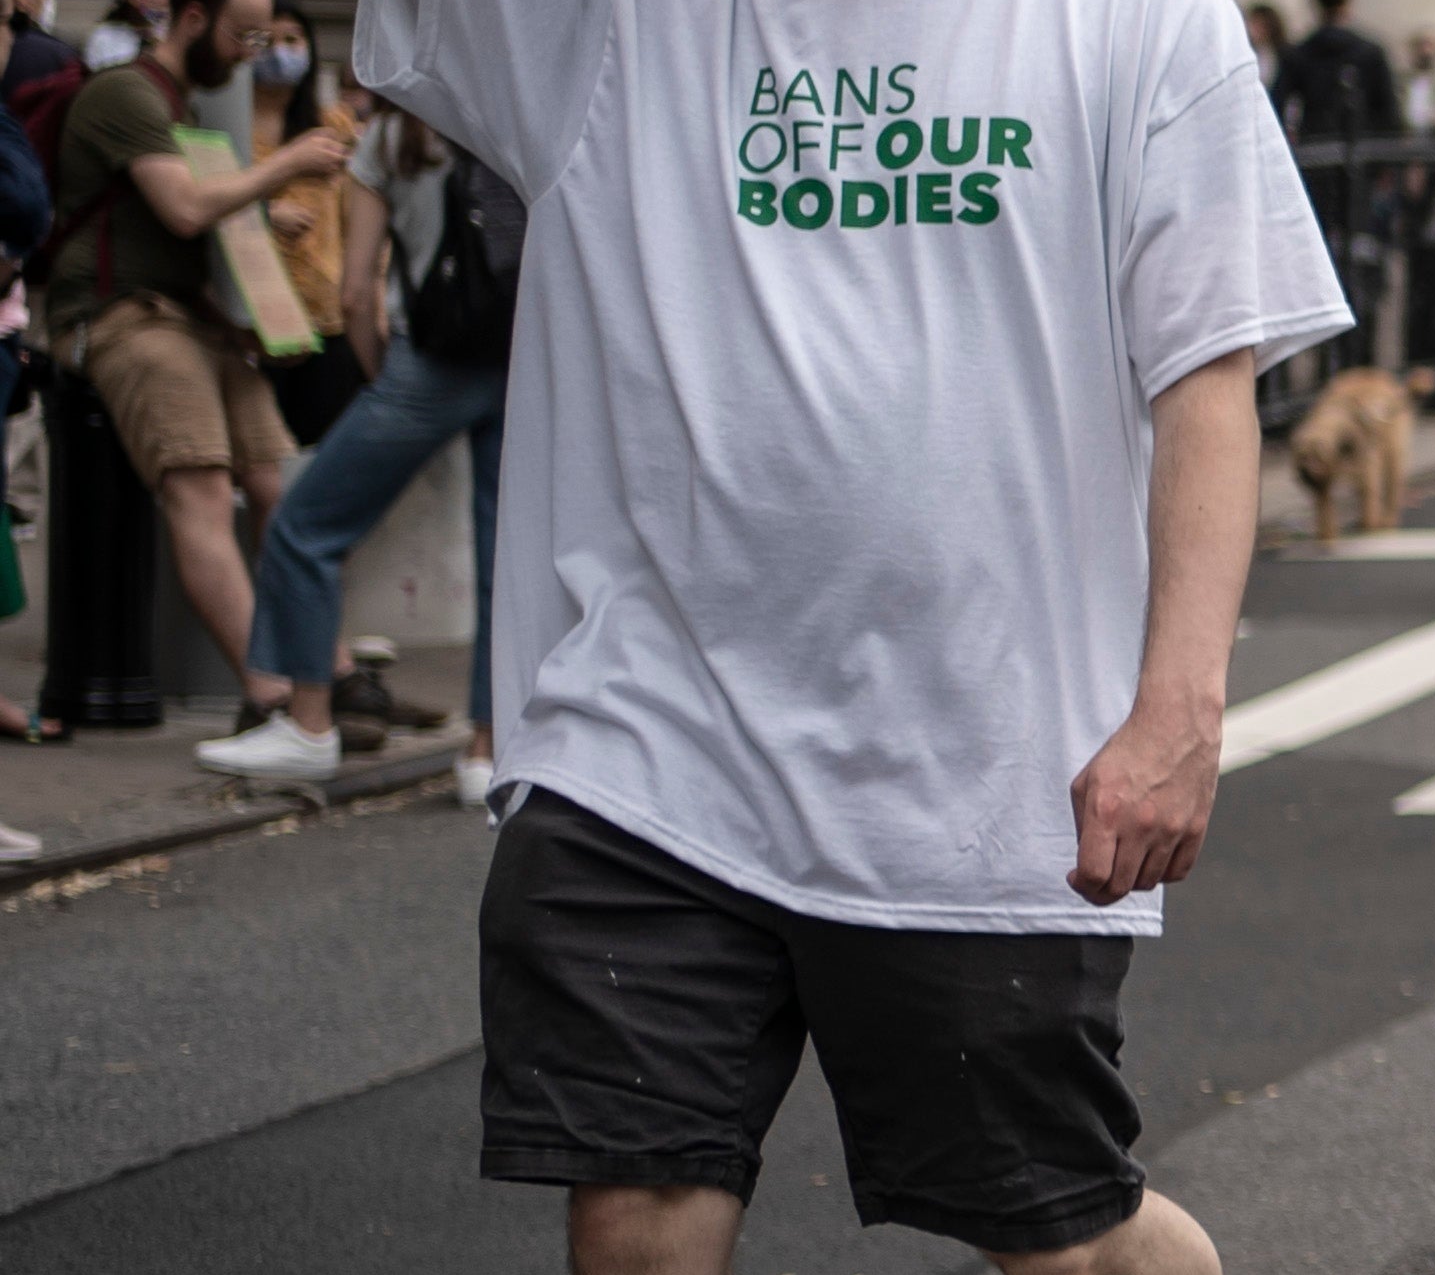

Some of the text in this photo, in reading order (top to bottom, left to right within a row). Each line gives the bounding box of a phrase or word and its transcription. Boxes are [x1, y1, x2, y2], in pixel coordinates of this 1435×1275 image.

[749, 64, 918, 116] BANS
[738, 117, 1034, 174] OFF OUR
[737, 171, 1002, 231] BODIES
